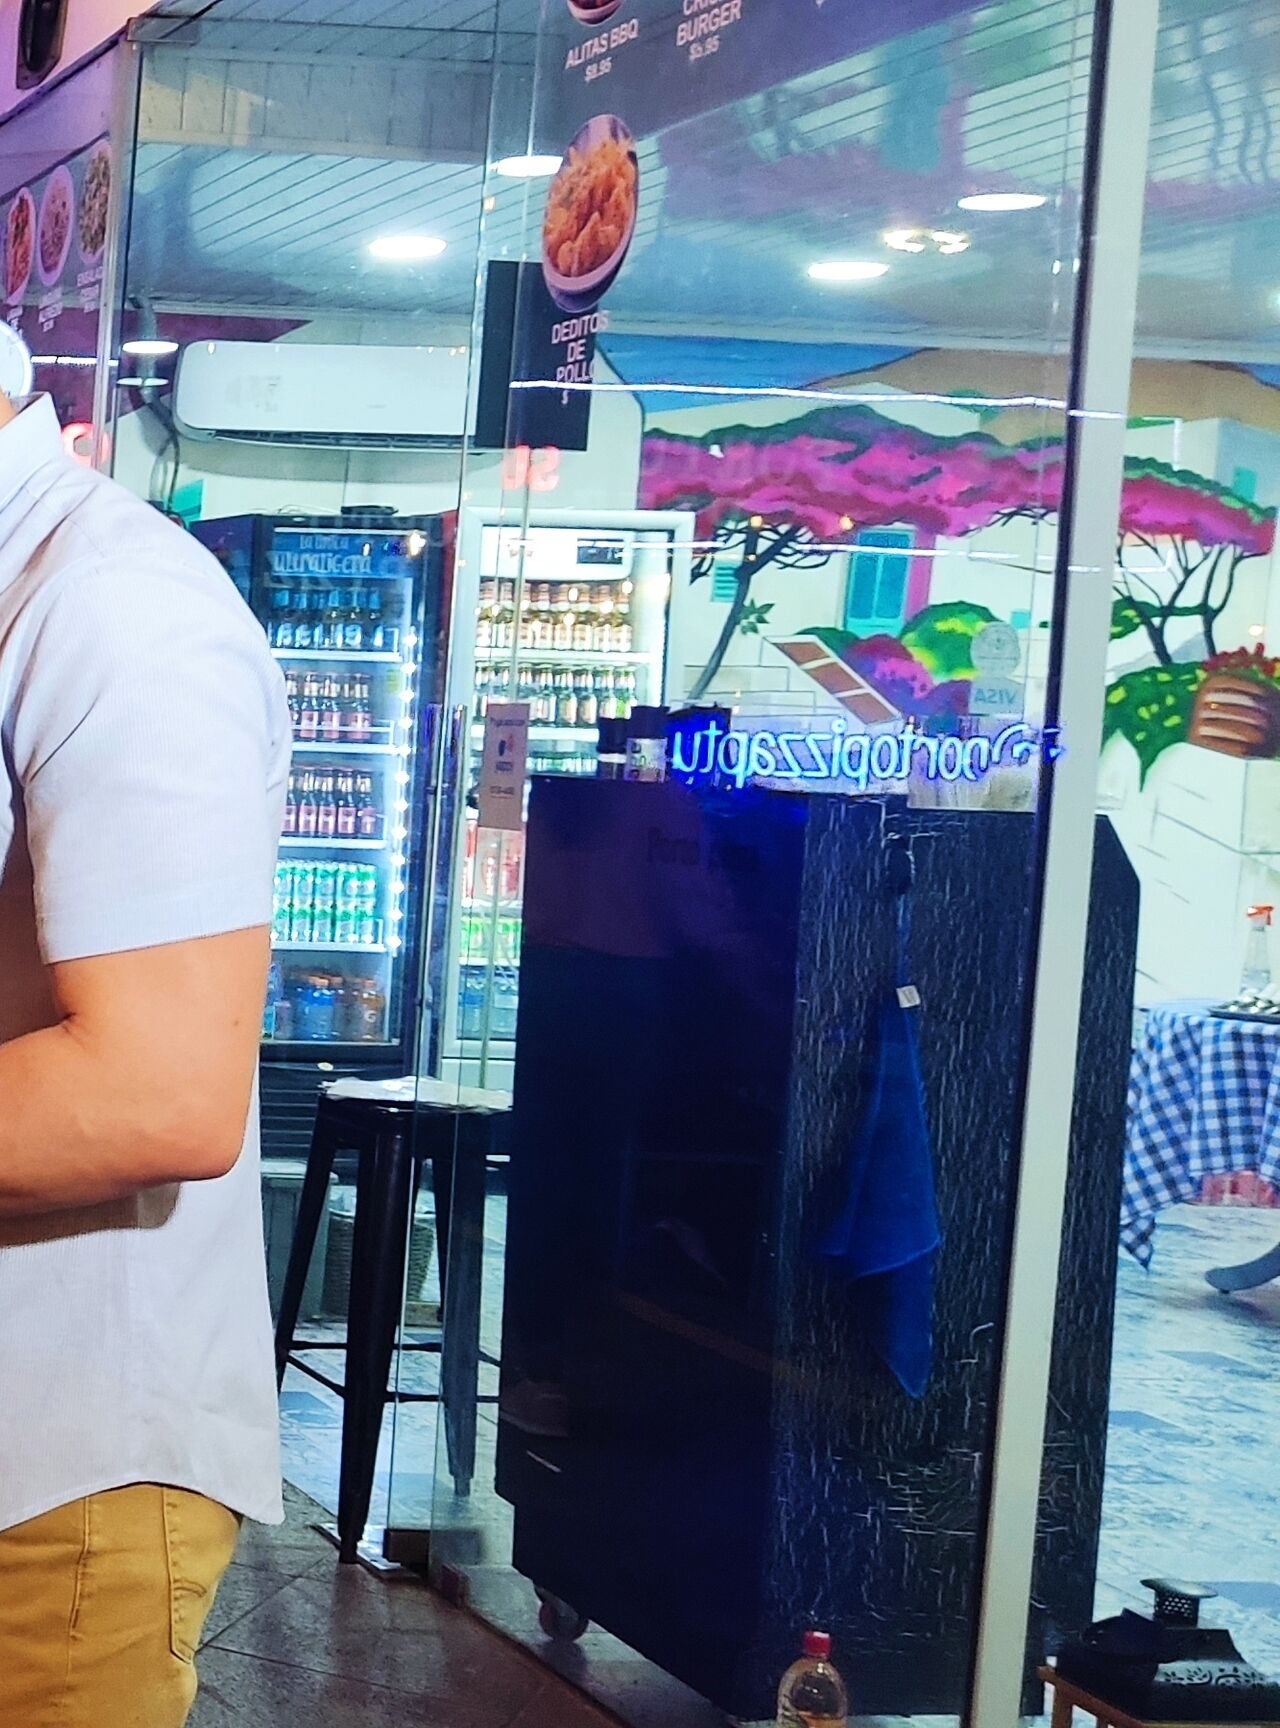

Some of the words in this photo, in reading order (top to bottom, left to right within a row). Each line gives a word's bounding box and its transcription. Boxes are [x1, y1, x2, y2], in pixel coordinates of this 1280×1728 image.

[676, 0, 742, 46] BURGER
[564, 33, 608, 70] ALITAS
[610, 18, 639, 48] BBQ
[552, 311, 609, 344] DEDITOS
[567, 339, 586, 363] DE
